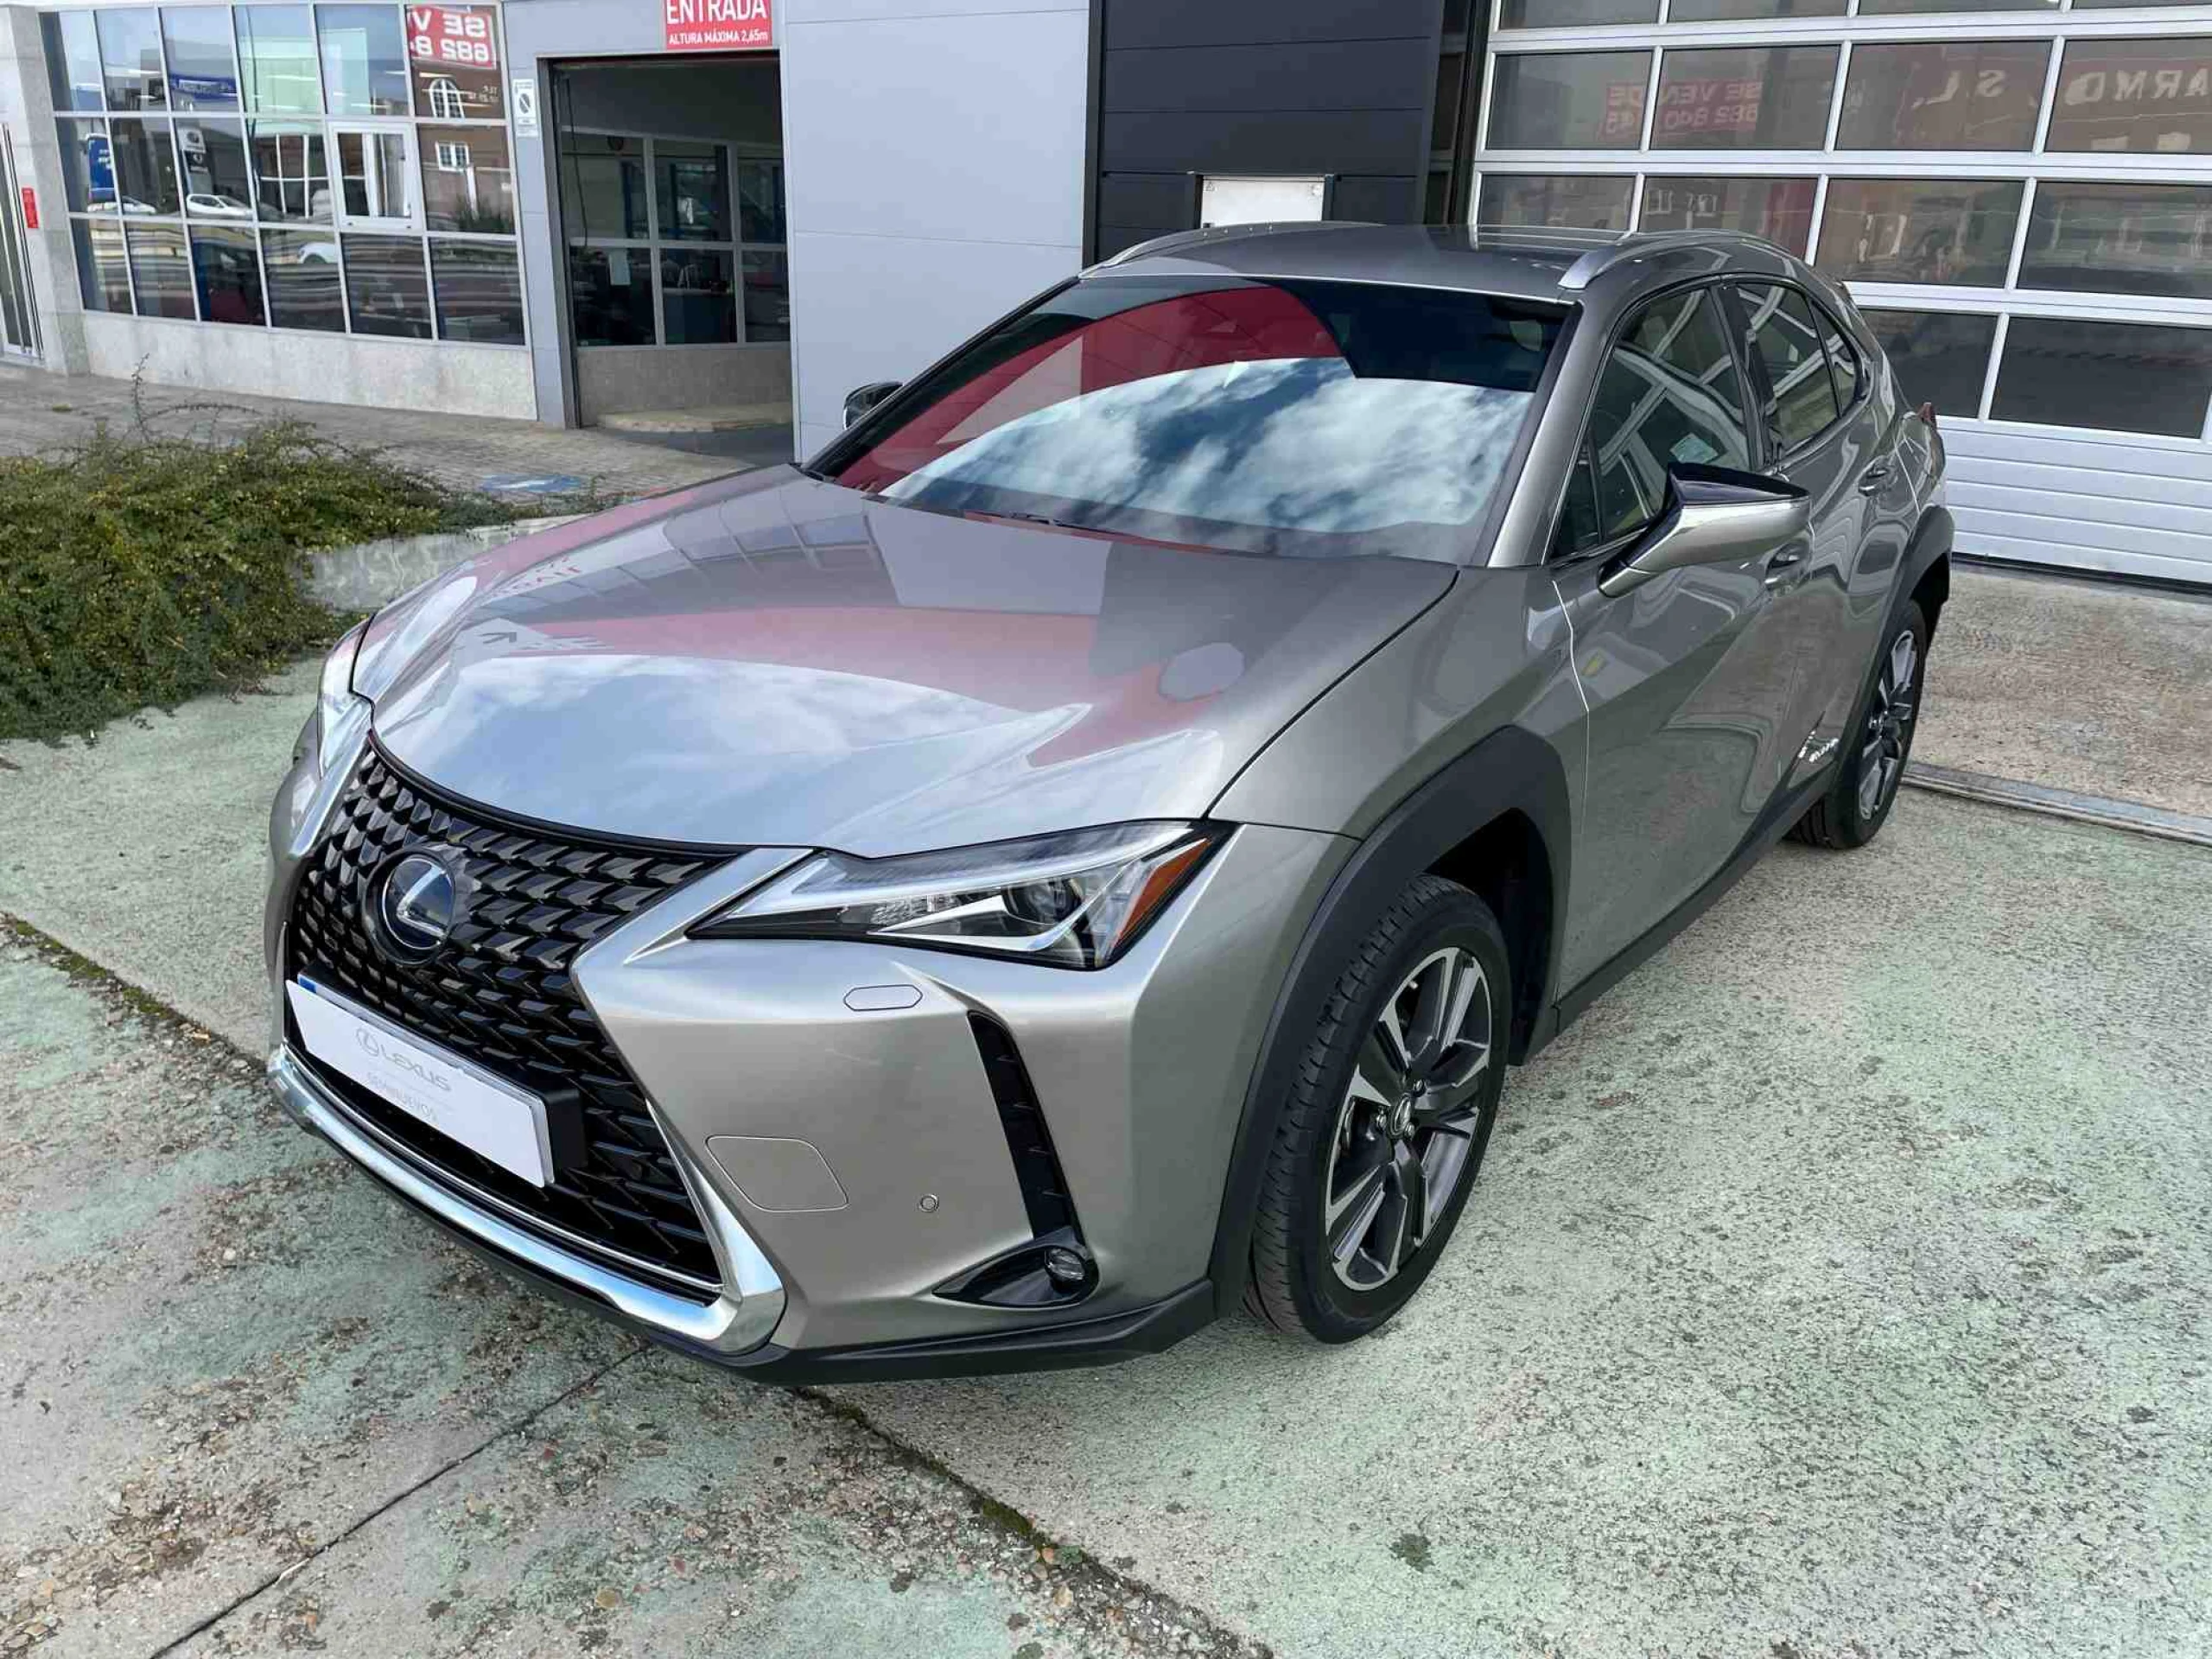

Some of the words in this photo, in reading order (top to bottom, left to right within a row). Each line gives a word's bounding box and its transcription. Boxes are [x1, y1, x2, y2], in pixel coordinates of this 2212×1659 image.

[666, 0, 768, 24] ENTRADA
[669, 32, 702, 44] ALTURA
[704, 29, 740, 42] MÁXIMA
[741, 28, 768, 43] 2,65m
[380, 1044, 452, 1091] LEXUS
